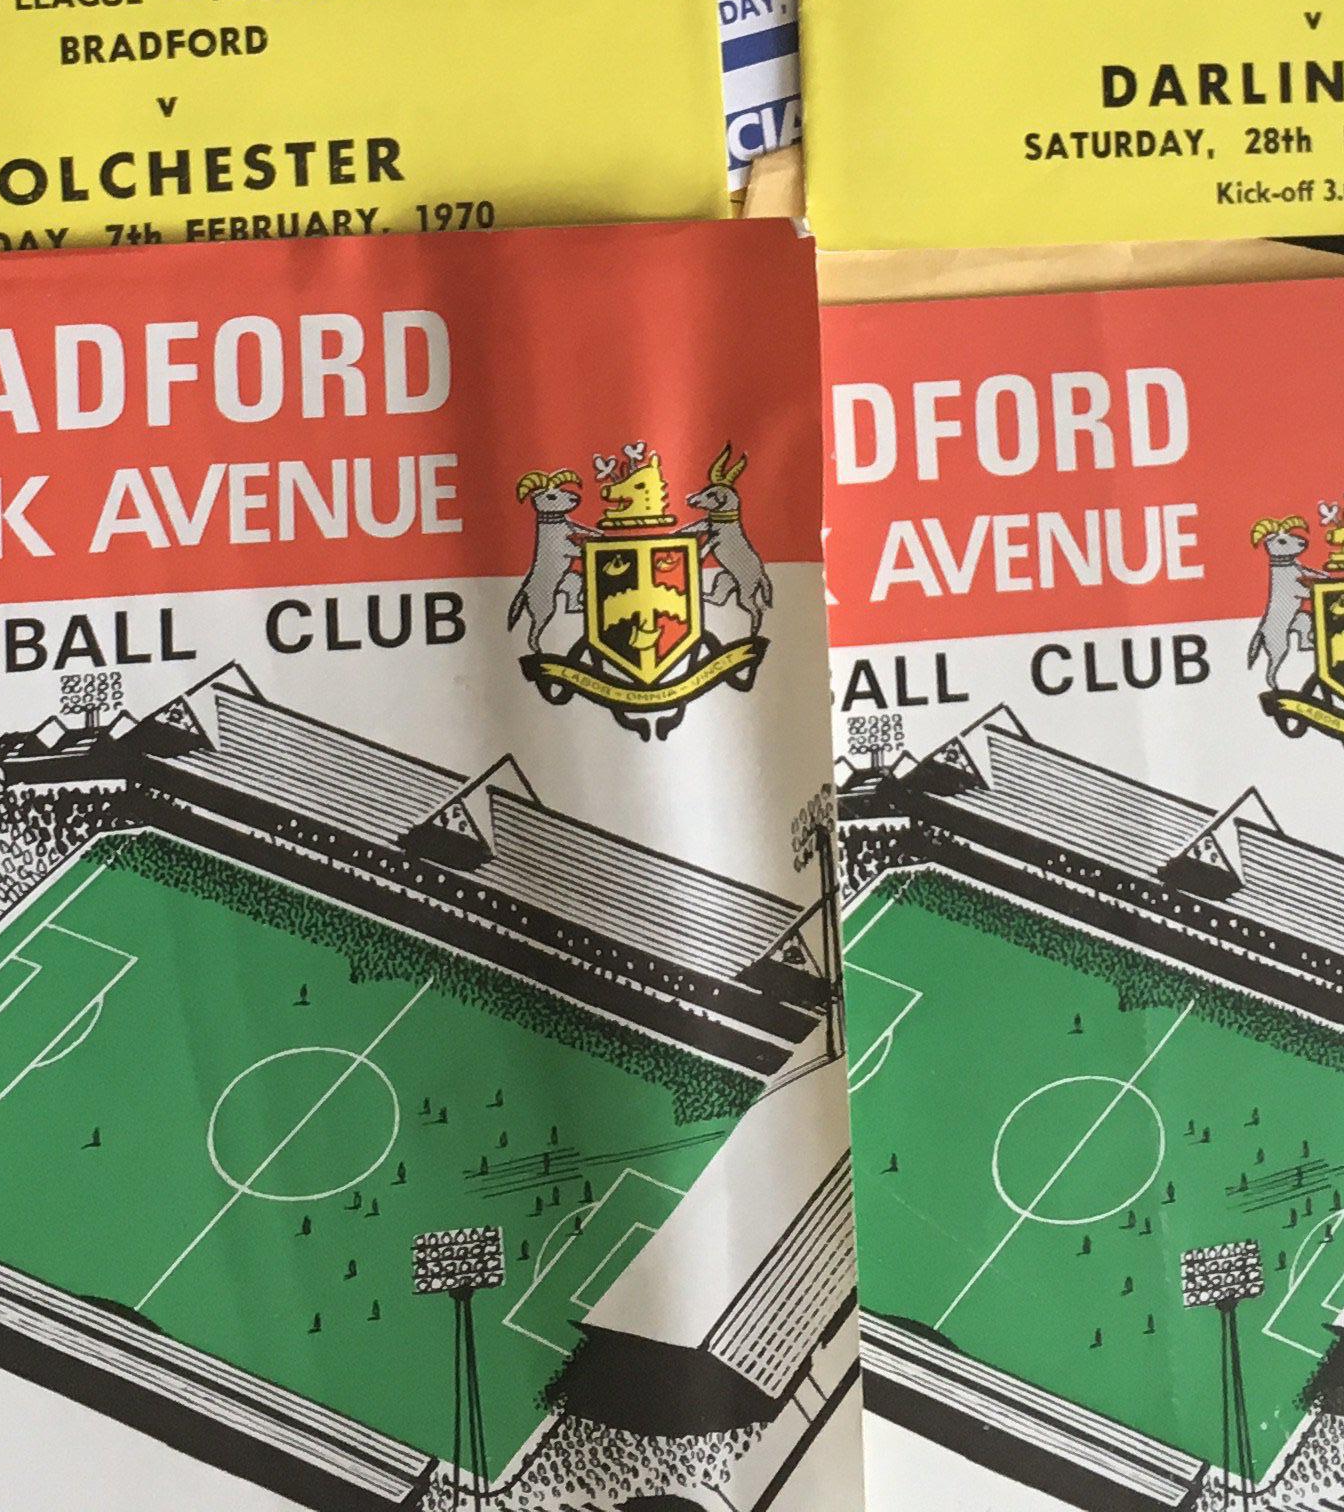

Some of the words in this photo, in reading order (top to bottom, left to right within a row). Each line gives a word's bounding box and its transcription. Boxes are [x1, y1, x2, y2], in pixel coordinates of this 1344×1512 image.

[1304, 10, 1323, 31] v
[59, 24, 269, 66] BRADFORD
[156, 96, 178, 119] v
[1023, 126, 1215, 161] SATURDAY,
[1244, 124, 1312, 155] 28th
[1216, 180, 1315, 206] Kick-off
[415, 200, 495, 232] 1970
[89, 451, 463, 557] AVENUE
[869, 501, 1206, 603] AVENUE
[265, 590, 468, 655] CLUB
[1029, 632, 1212, 701] CLUB
